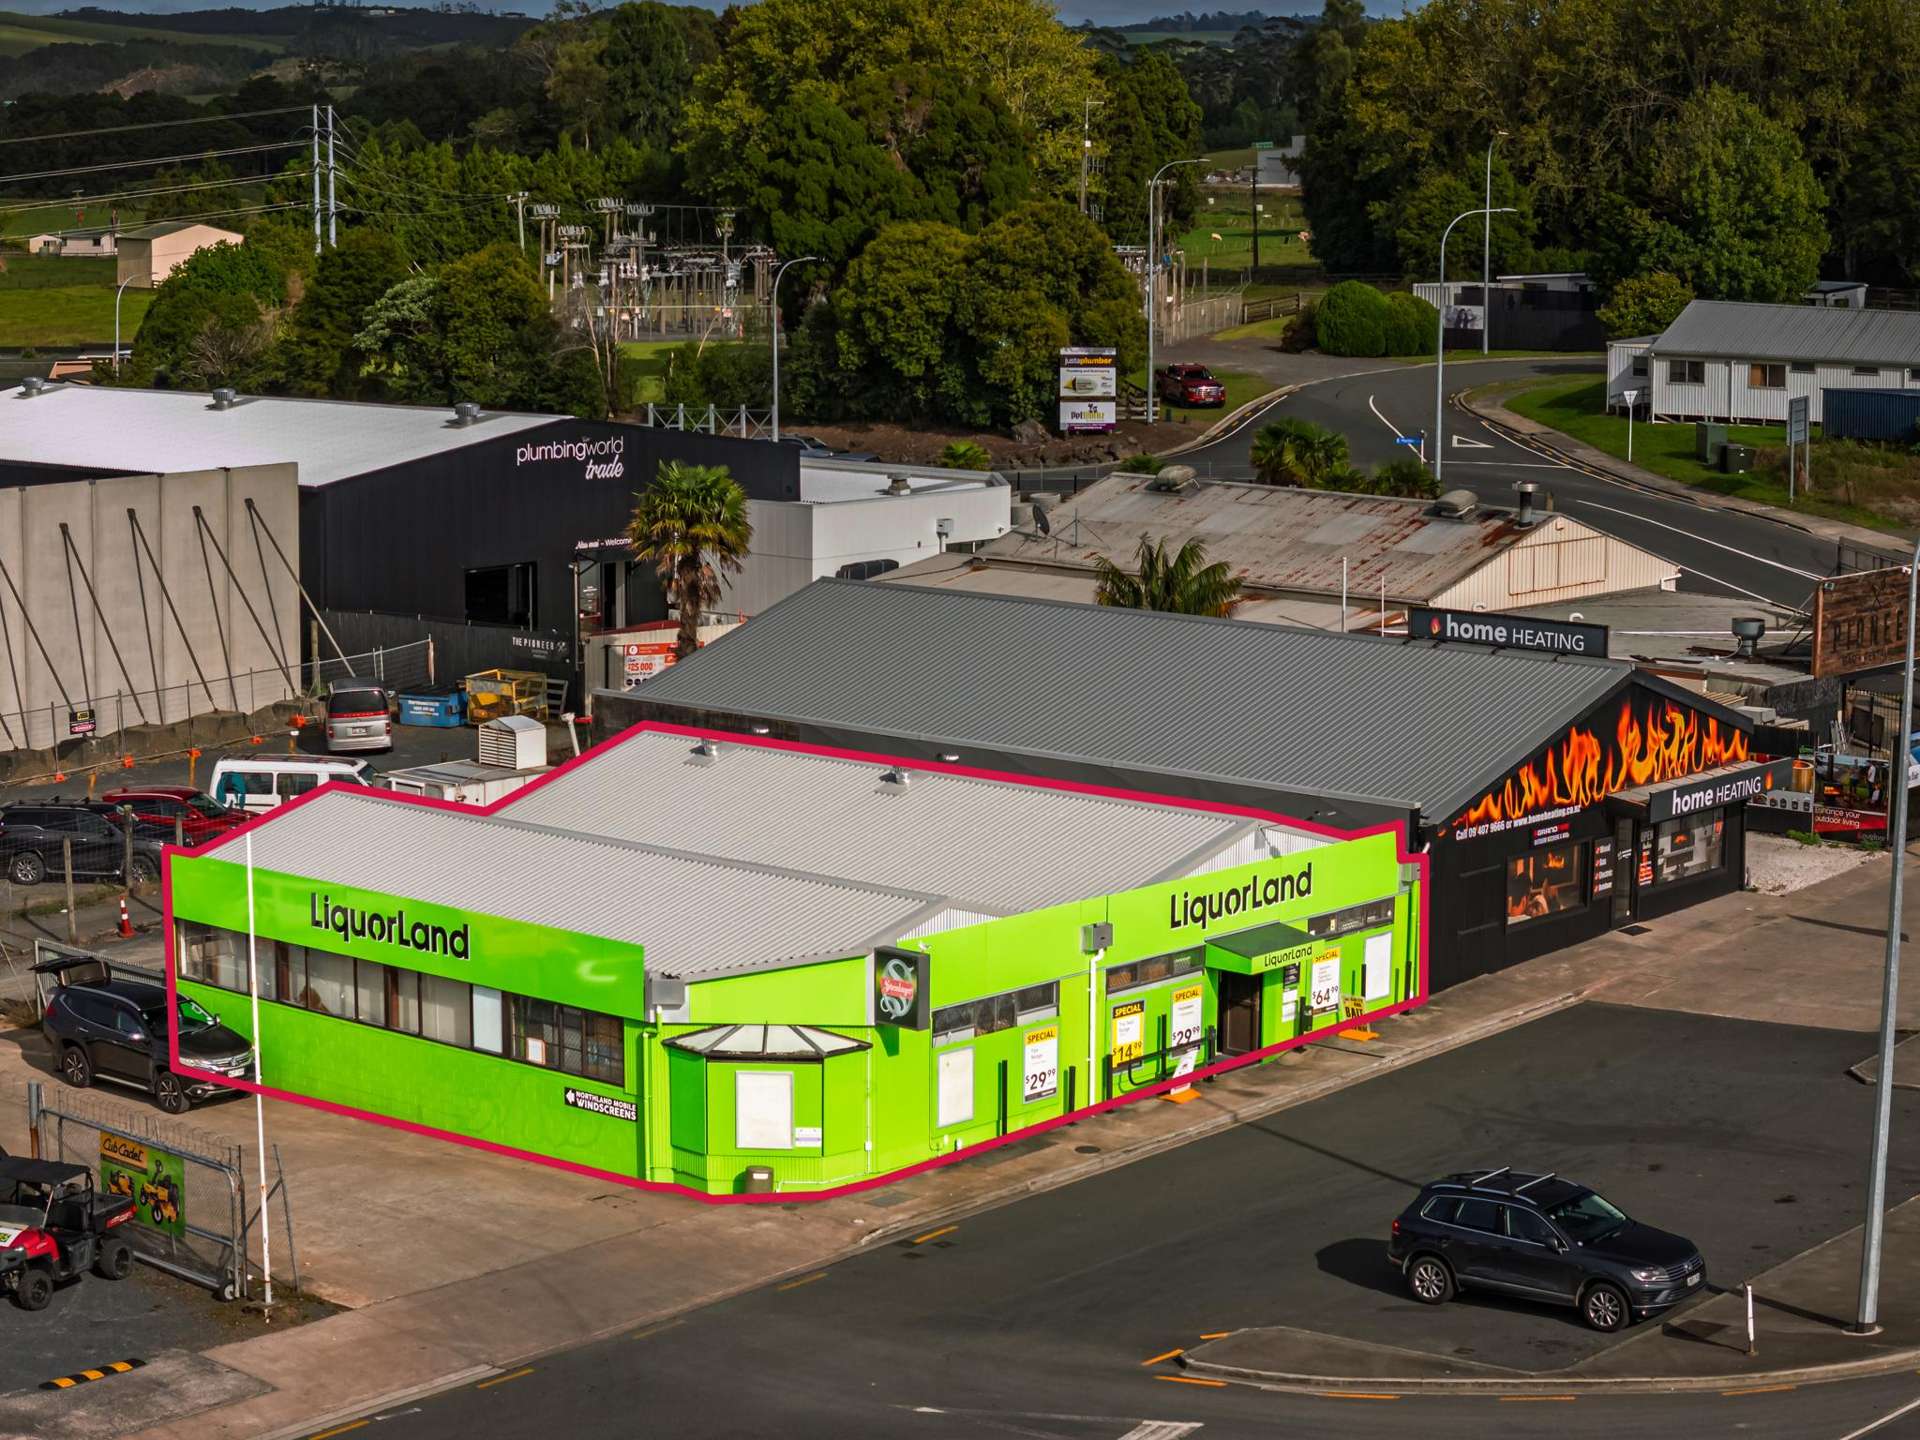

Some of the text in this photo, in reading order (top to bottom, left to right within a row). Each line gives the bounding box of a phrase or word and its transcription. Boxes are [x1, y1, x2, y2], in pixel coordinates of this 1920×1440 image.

[516, 435, 624, 466] plumbingworld
[585, 454, 624, 480] trade
[512, 636, 554, 651] THE PIONEER
[1446, 614, 1585, 652] home HEATING
[1672, 776, 1761, 815] home HEATING
[1814, 806, 1861, 820] Enhance your
[1815, 816, 1861, 830] outdoor living
[1456, 828, 1468, 841] Call
[1468, 826, 1477, 838] 09
[1506, 819, 1513, 829] or
[1170, 862, 1313, 930] LiquorLand
[311, 892, 471, 961] LiquorLand
[1264, 944, 1313, 968] LiquorLand
[1175, 989, 1200, 1001] SPECIAL
[1114, 1003, 1142, 1018] SPECIAL
[1027, 1030, 1056, 1044] SPECIAL
[575, 1091, 637, 1112] NORTHLAND MOBILE
[576, 1098, 637, 1121] WINDSCREENS
[103, 1138, 144, 1162] Cub Cadet
